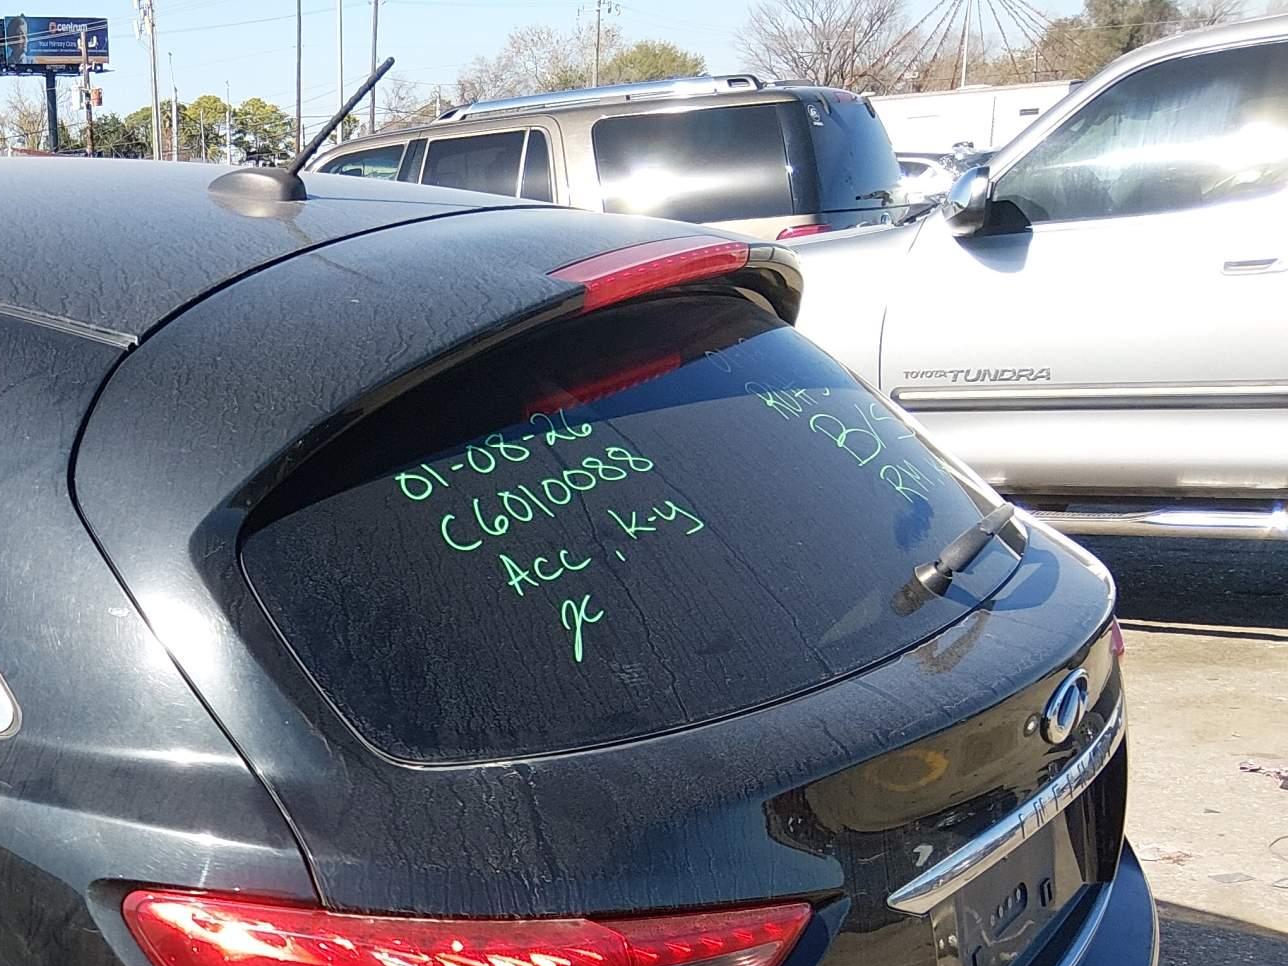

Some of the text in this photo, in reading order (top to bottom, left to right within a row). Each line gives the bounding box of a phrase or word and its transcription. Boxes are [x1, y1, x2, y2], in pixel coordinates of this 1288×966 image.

[903, 367, 1051, 383] TOYOTA TUNDRA
[394, 408, 593, 501] 01-08-26
[440, 446, 654, 551] C6010088
